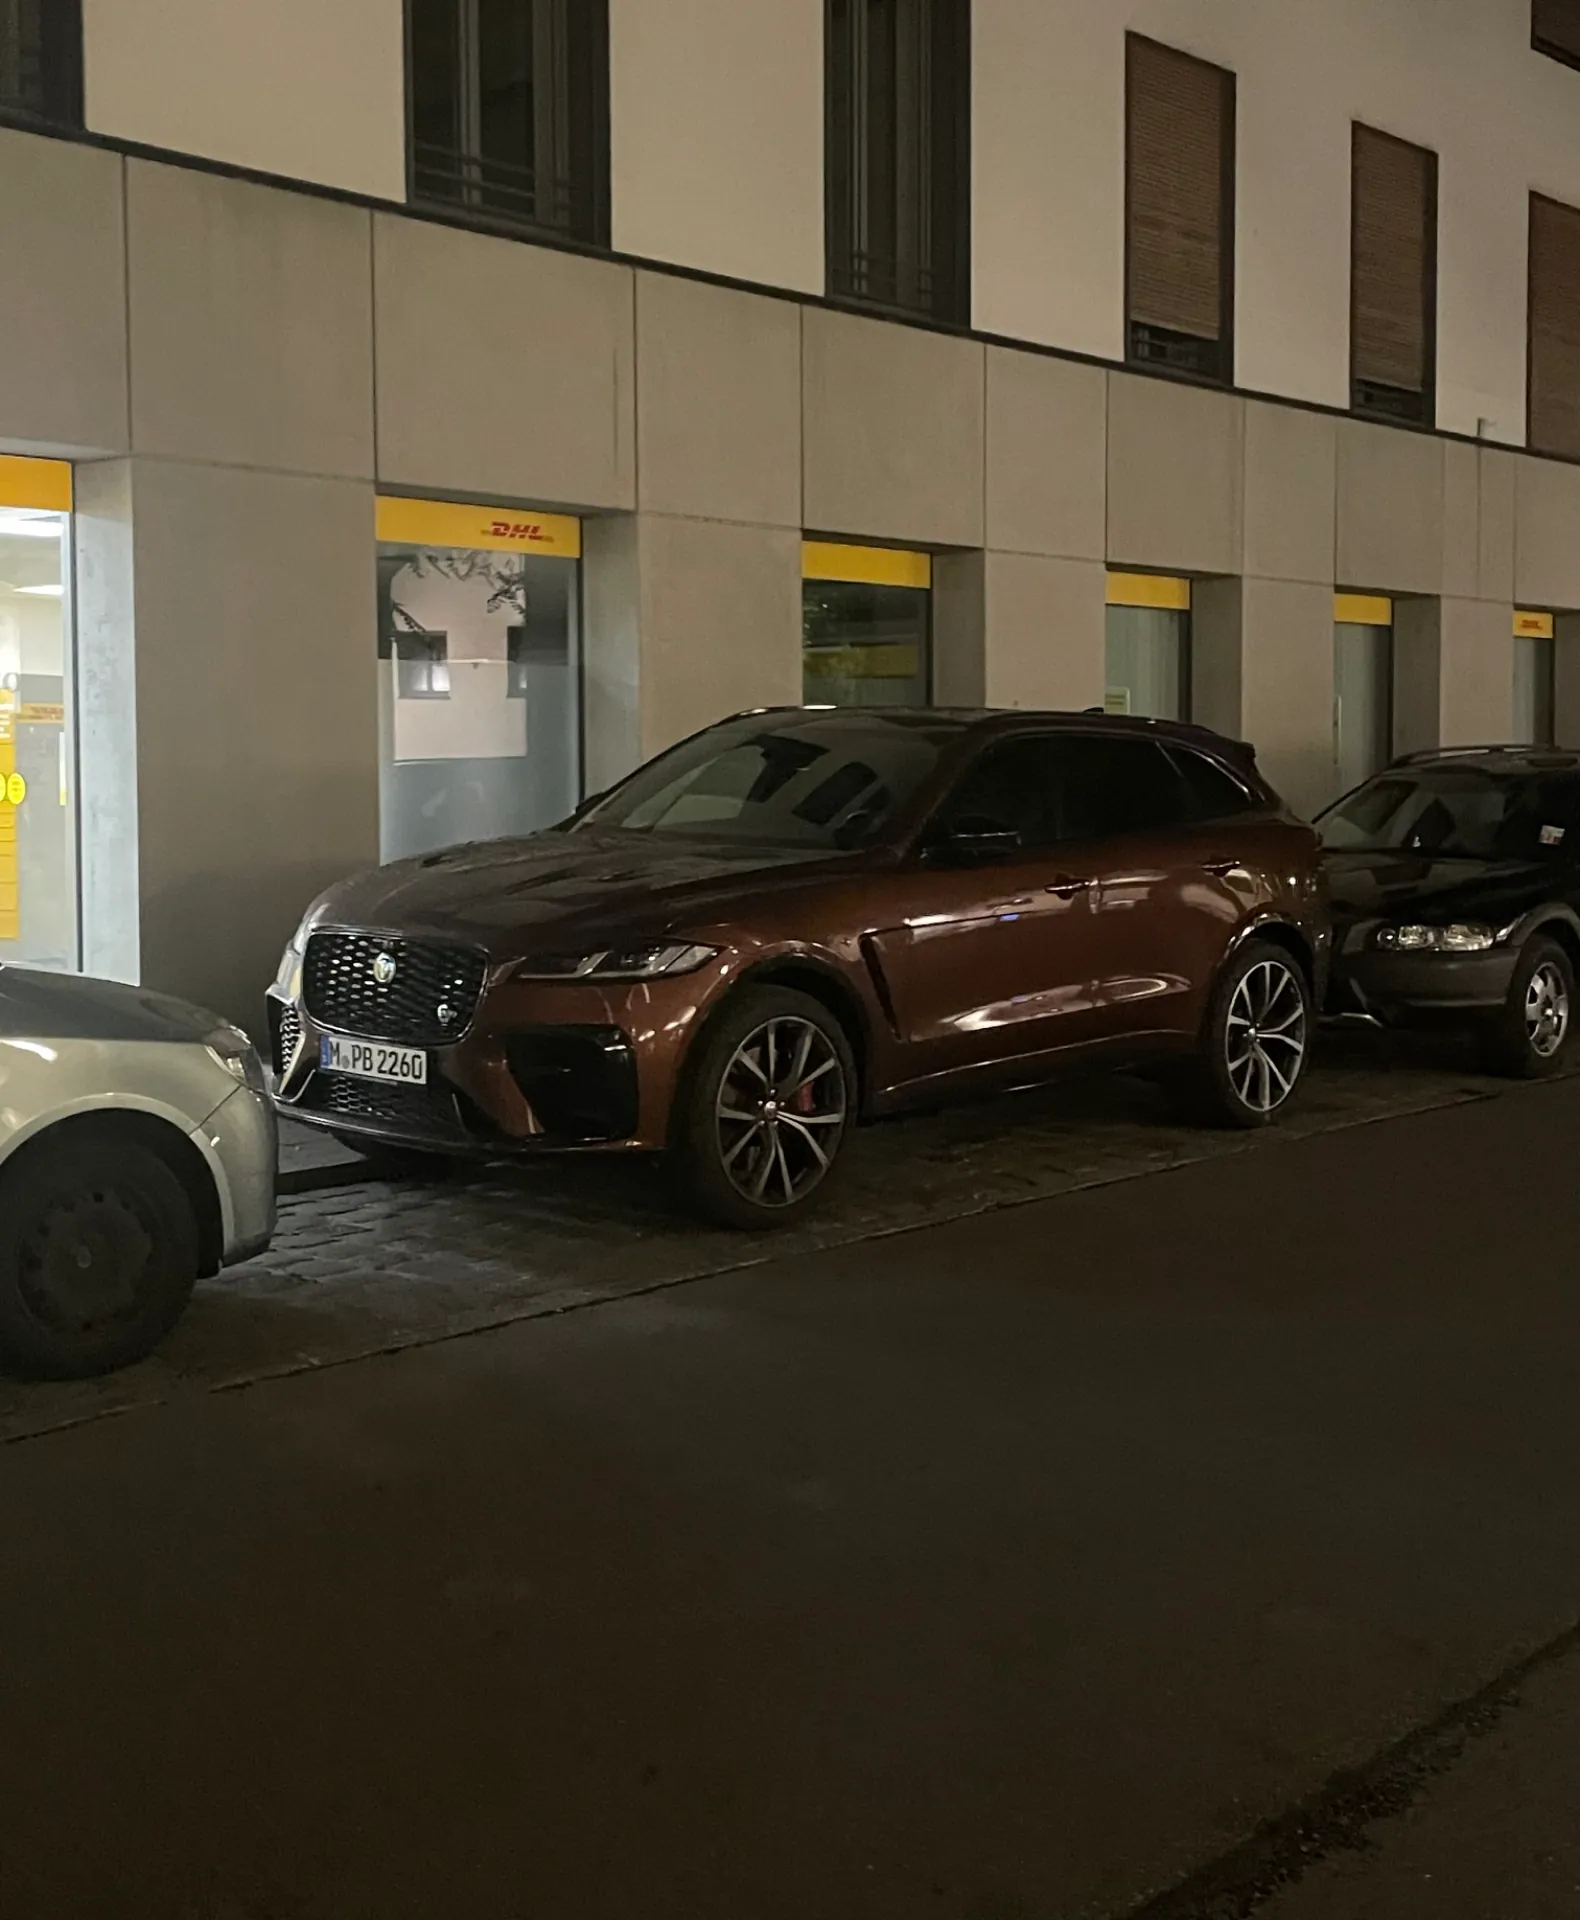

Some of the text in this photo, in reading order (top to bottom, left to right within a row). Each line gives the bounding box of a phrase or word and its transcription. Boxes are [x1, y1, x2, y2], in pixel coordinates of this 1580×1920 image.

[490, 521, 543, 541] DHL
[329, 1041, 422, 1079] M PB 2260
